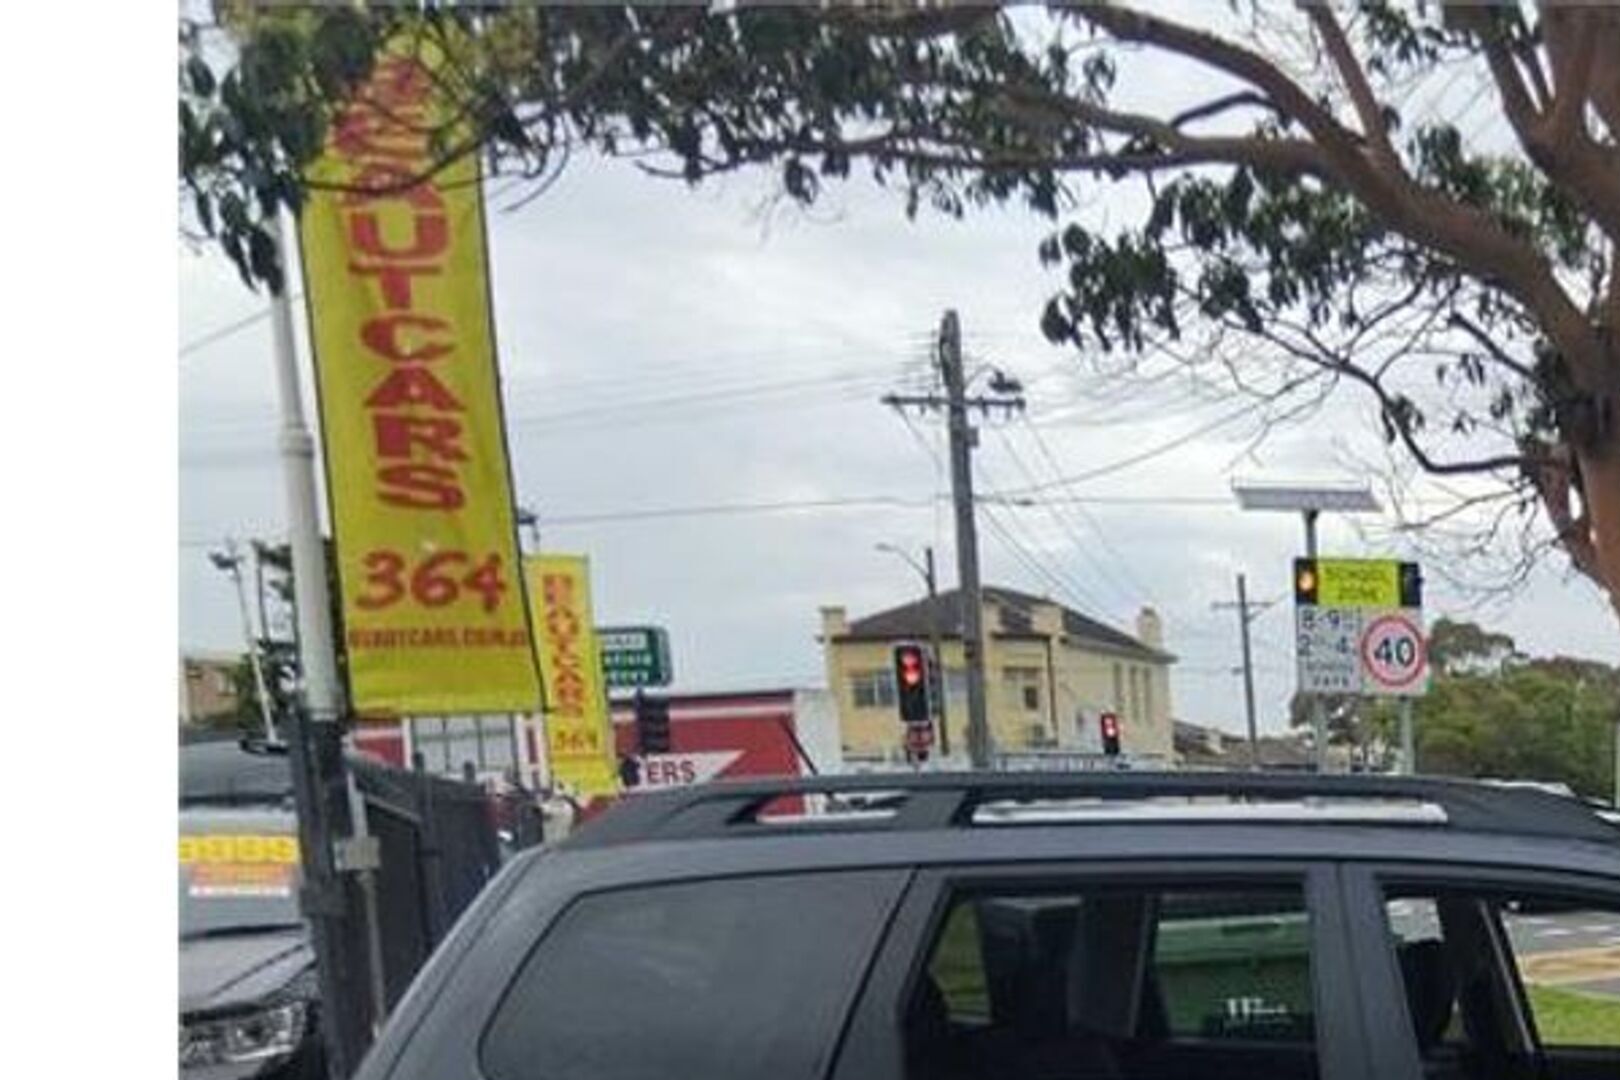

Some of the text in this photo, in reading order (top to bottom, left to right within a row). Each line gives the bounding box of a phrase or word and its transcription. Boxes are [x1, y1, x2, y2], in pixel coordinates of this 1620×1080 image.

[355, 550, 506, 614] 364
[1374, 636, 1416, 667] 40
[646, 760, 696, 785] ERS
